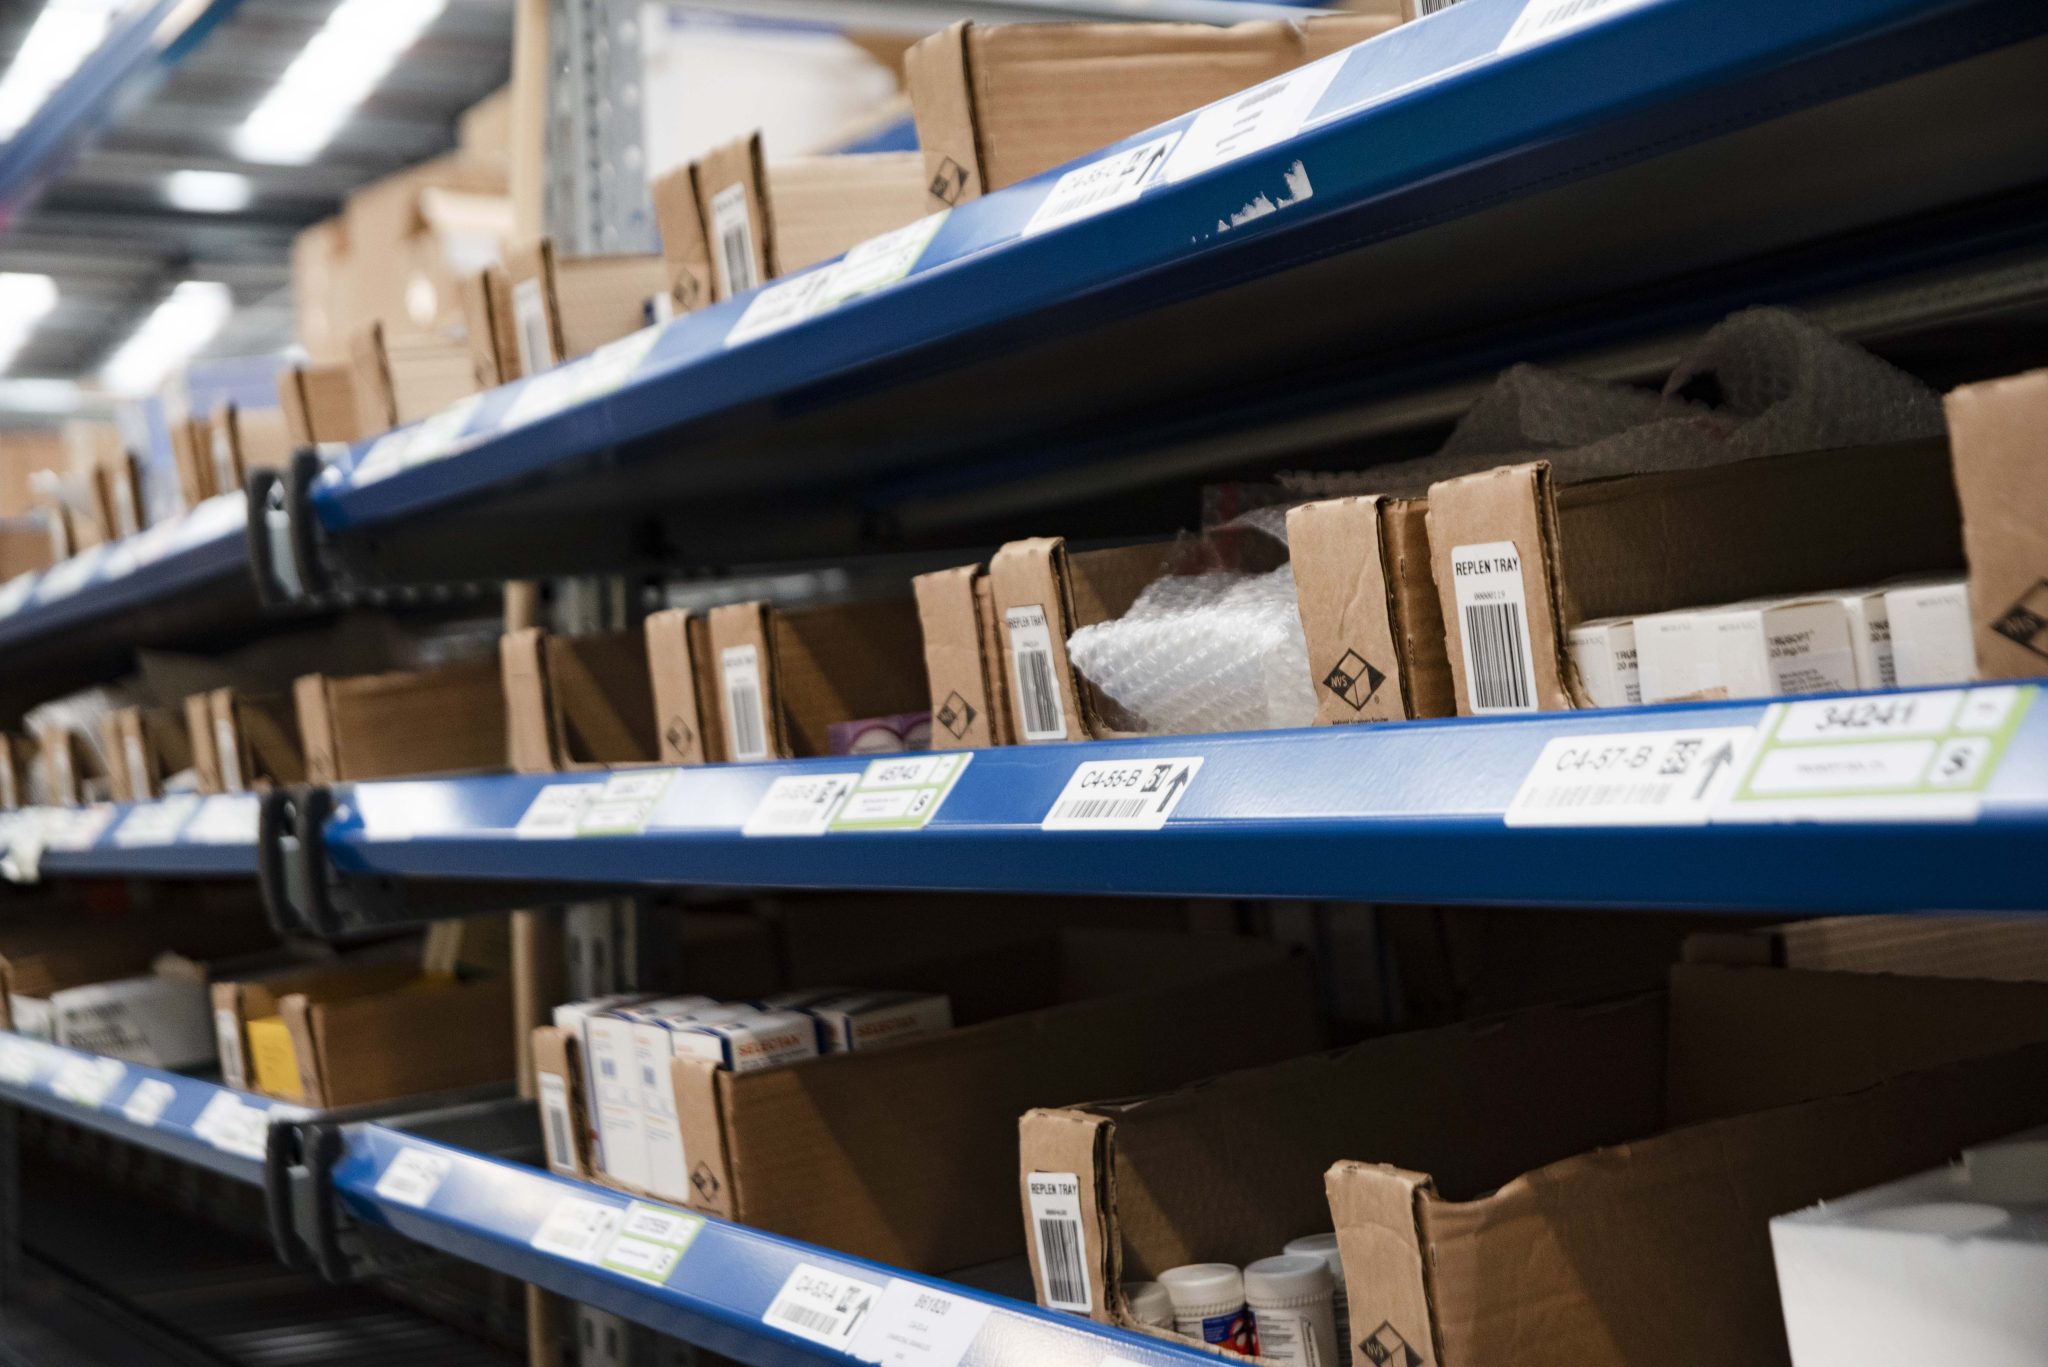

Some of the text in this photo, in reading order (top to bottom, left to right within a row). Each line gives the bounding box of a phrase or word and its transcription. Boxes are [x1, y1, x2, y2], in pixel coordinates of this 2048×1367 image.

[1455, 556, 1518, 576] REPLEN TRAY
[1331, 674, 1348, 688] NVS
[1556, 746, 1652, 771] C4-57-B
[1080, 769, 1143, 788] C4-55-B
[1031, 1183, 1077, 1195] REPLEN TRAY
[1366, 1341, 1384, 1360] NVS
